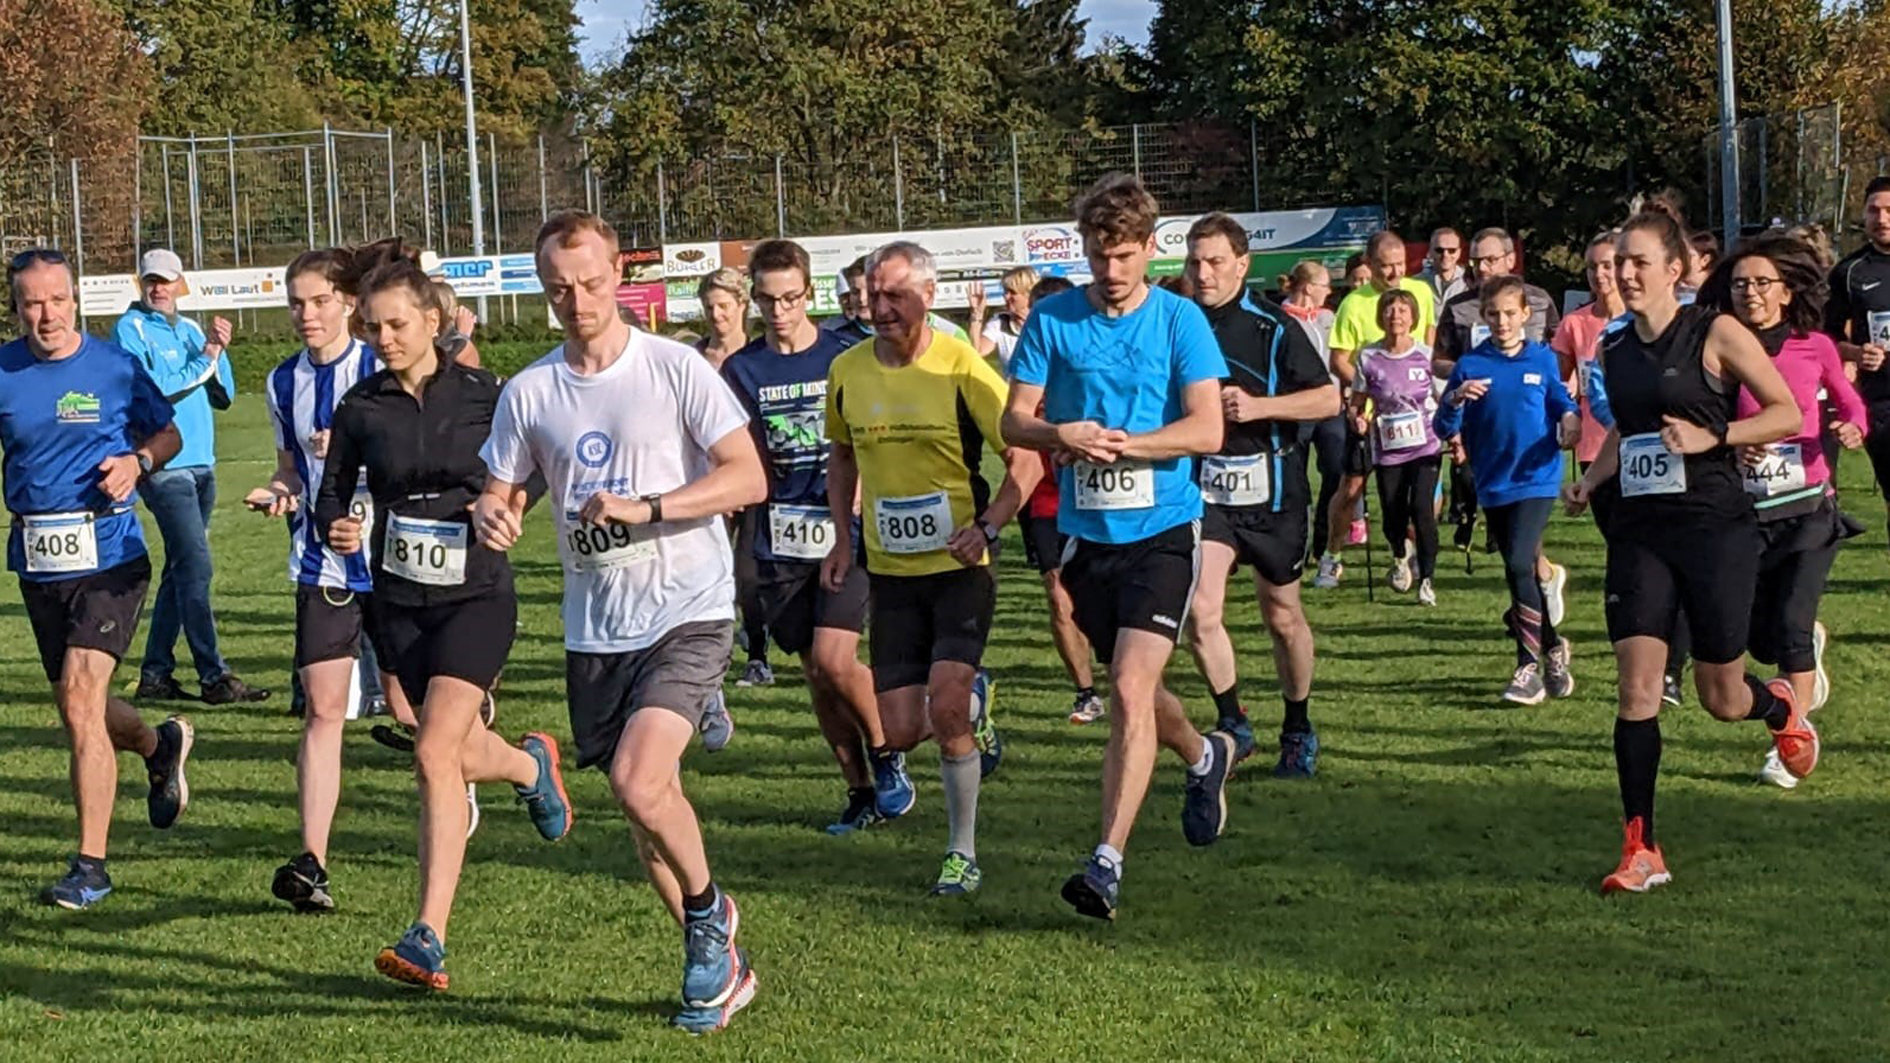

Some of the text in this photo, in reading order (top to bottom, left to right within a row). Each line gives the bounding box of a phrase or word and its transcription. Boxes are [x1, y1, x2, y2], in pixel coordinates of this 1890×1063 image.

[1027, 237, 1072, 252] SPORT
[1044, 251, 1071, 261] ECKE
[759, 385, 788, 402] STATE
[789, 383, 802, 399] OF
[1387, 424, 1414, 440] 811
[1628, 453, 1668, 479] 405
[1746, 461, 1791, 483] 444
[1086, 467, 1135, 493] 406
[1211, 472, 1252, 493] 401
[783, 521, 826, 544] 410
[888, 513, 937, 540] 808
[35, 533, 79, 557] 408
[574, 523, 631, 556] 809
[395, 538, 446, 569] 810
